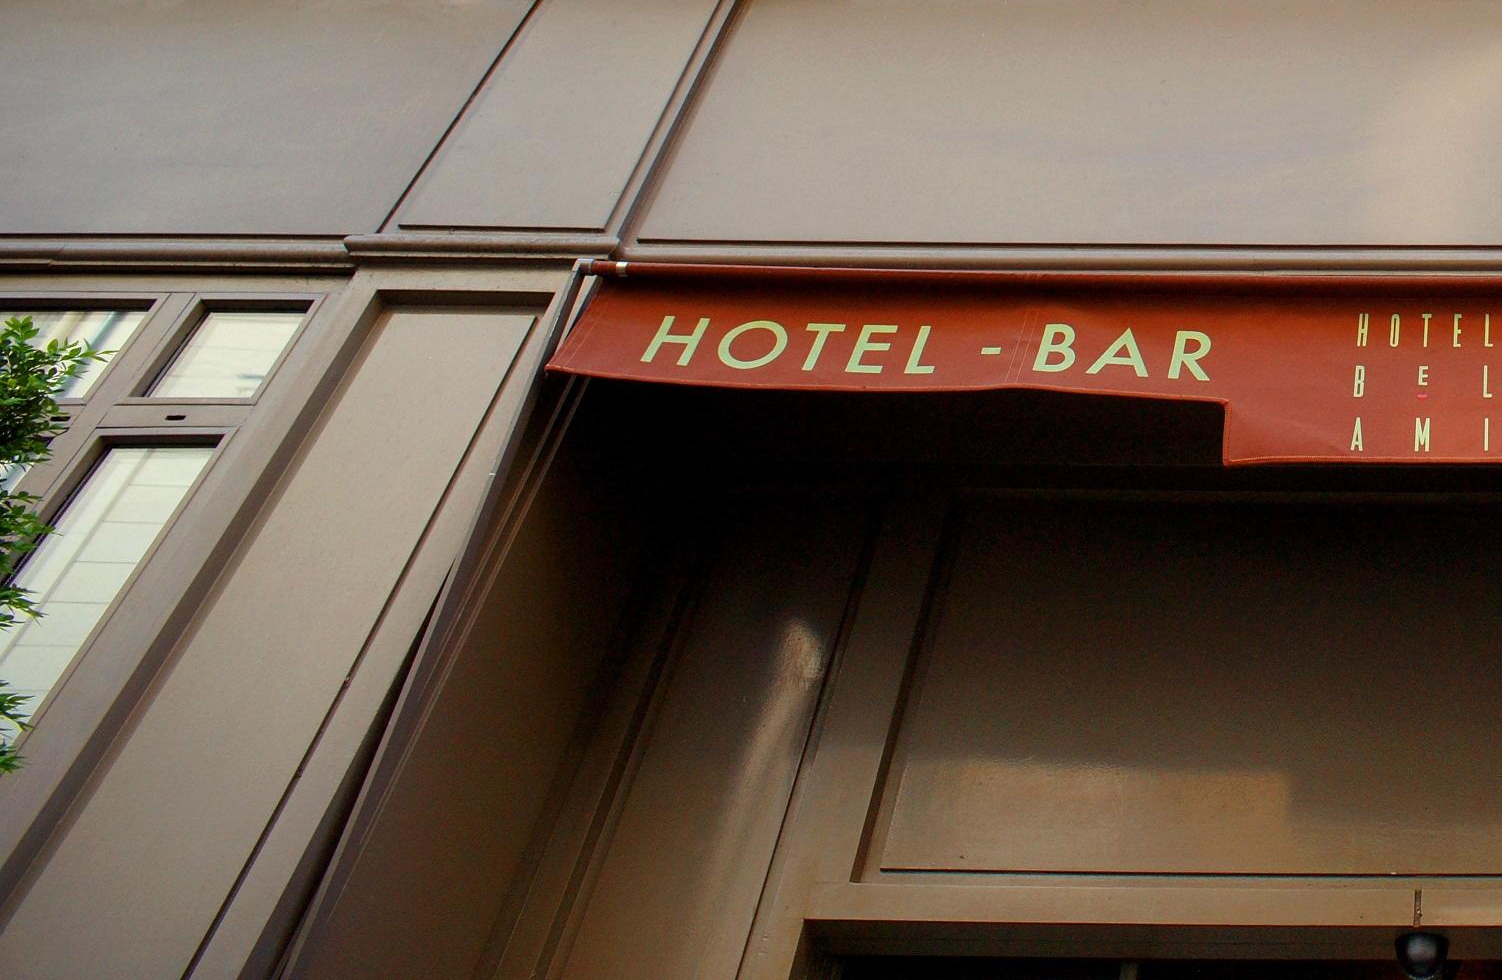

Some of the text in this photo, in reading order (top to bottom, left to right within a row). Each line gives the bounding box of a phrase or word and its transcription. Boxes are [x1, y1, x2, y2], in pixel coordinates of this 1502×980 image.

[1356, 313, 1494, 348] HOTEL
[640, 315, 936, 375] HOTEL
[1031, 323, 1212, 382] BAR
[1353, 365, 1493, 398] BEL
[1350, 417, 1490, 452] AMI
